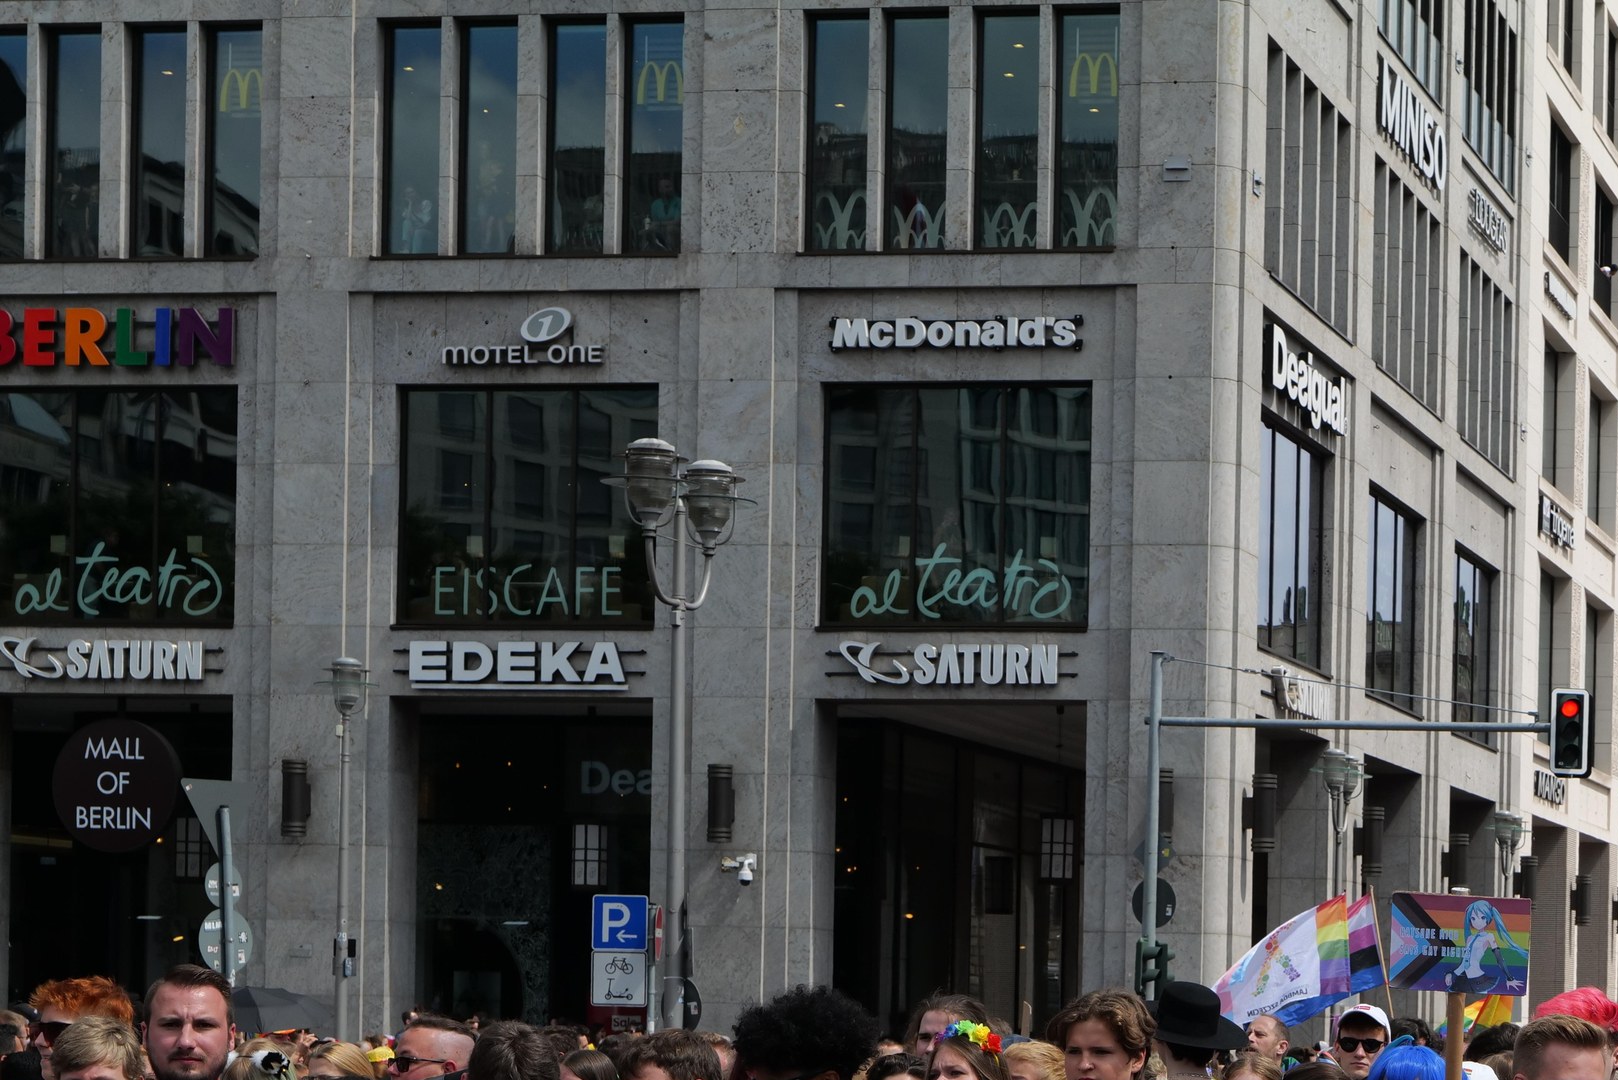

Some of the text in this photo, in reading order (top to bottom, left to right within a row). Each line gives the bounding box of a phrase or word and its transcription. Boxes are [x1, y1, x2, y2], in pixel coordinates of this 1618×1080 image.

[1381, 58, 1447, 190] MINISO
[832, 316, 1077, 349] McDonald's
[441, 344, 605, 365] MOTEL ONE
[15, 566, 67, 616] al
[850, 573, 910, 619] al
[66, 638, 204, 681] SATURN
[408, 640, 626, 683] EDEKA
[912, 642, 1059, 686] SATURN
[84, 736, 145, 761] MALL
[96, 770, 130, 795] OF
[75, 806, 151, 831] BERLIN
[601, 902, 631, 943] P
[1422, 945, 1438, 957] GAY
